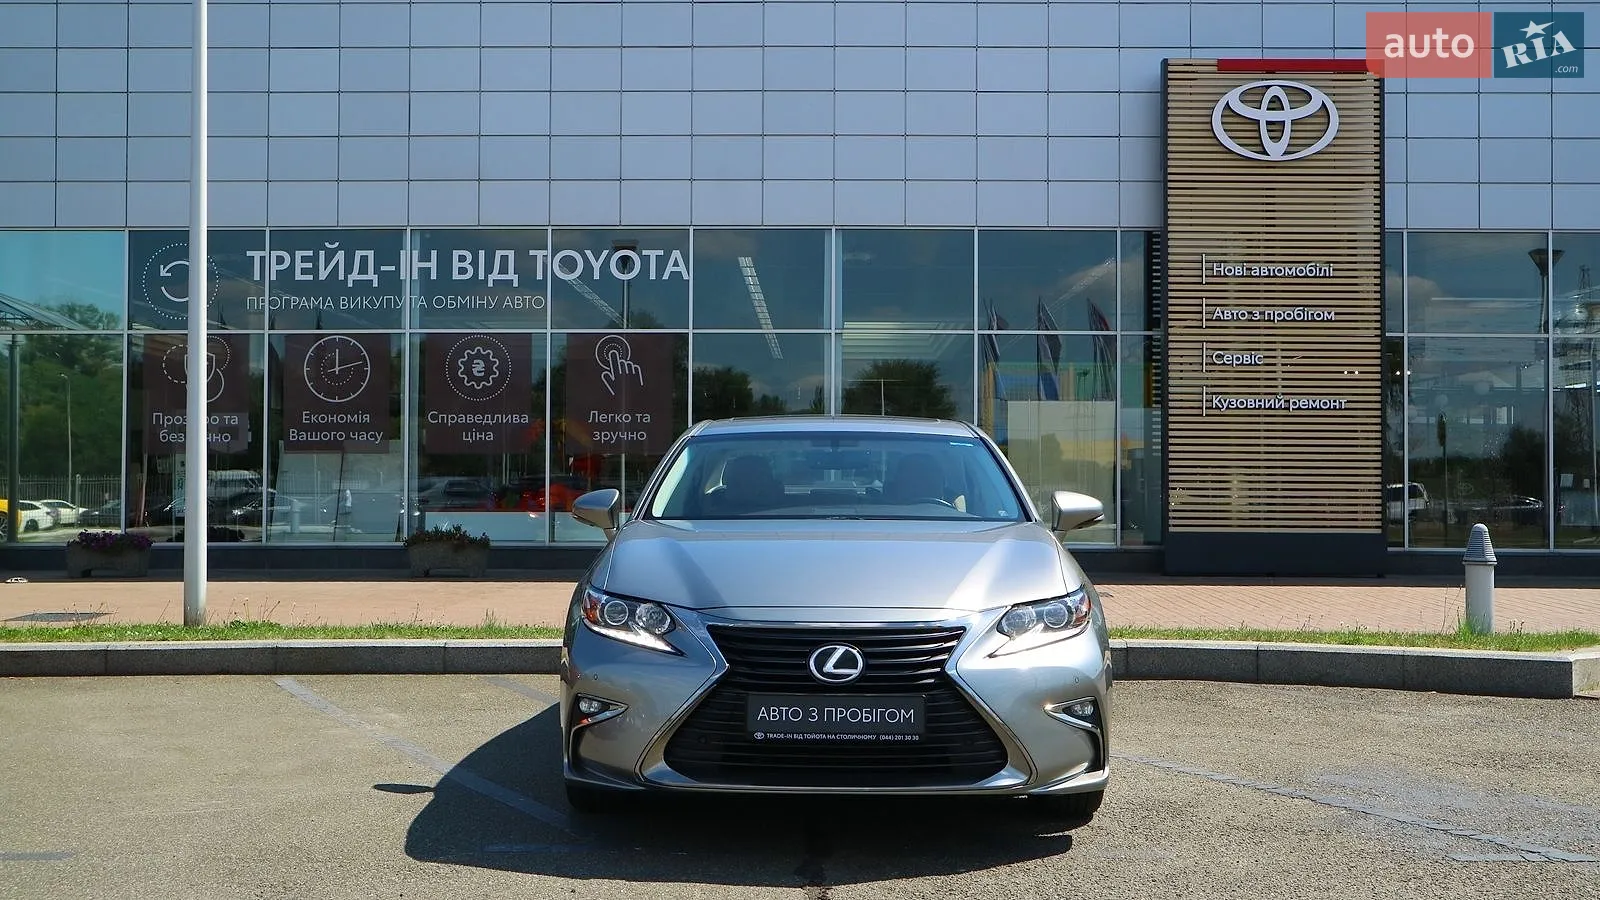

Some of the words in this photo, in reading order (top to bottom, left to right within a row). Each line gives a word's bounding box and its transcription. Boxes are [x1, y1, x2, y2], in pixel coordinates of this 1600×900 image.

[246, 241, 437, 288] ТРЕЙД-ІН
[452, 249, 519, 288] ВІД
[529, 249, 690, 281] TOYOTA
[1212, 263, 1247, 277] Нові
[1251, 263, 1334, 278] автомобілі
[246, 296, 335, 311] ПРОГРАМА
[340, 295, 406, 310] ВИКУПУ
[409, 295, 428, 309] ТА
[432, 295, 499, 310] ОБМІНУ
[503, 296, 545, 310] АВТО
[1212, 307, 1248, 321] Авто
[1252, 310, 1260, 321] з
[1264, 307, 1335, 324] пробігом
[1212, 351, 1264, 367] Сервіс
[1211, 394, 1286, 412] Кузовний
[1289, 399, 1347, 413] ремонт
[223, 415, 239, 425] та
[302, 411, 370, 424] Економія
[427, 411, 529, 426] Справедлива
[588, 411, 632, 423] Легко
[635, 413, 651, 422] та
[289, 428, 346, 441] Вашого
[350, 431, 384, 444] часу
[462, 428, 494, 442] ціна
[592, 429, 647, 443] зручно
[757, 706, 802, 721] АВТО
[824, 707, 914, 723] ПРОБІГОМ
